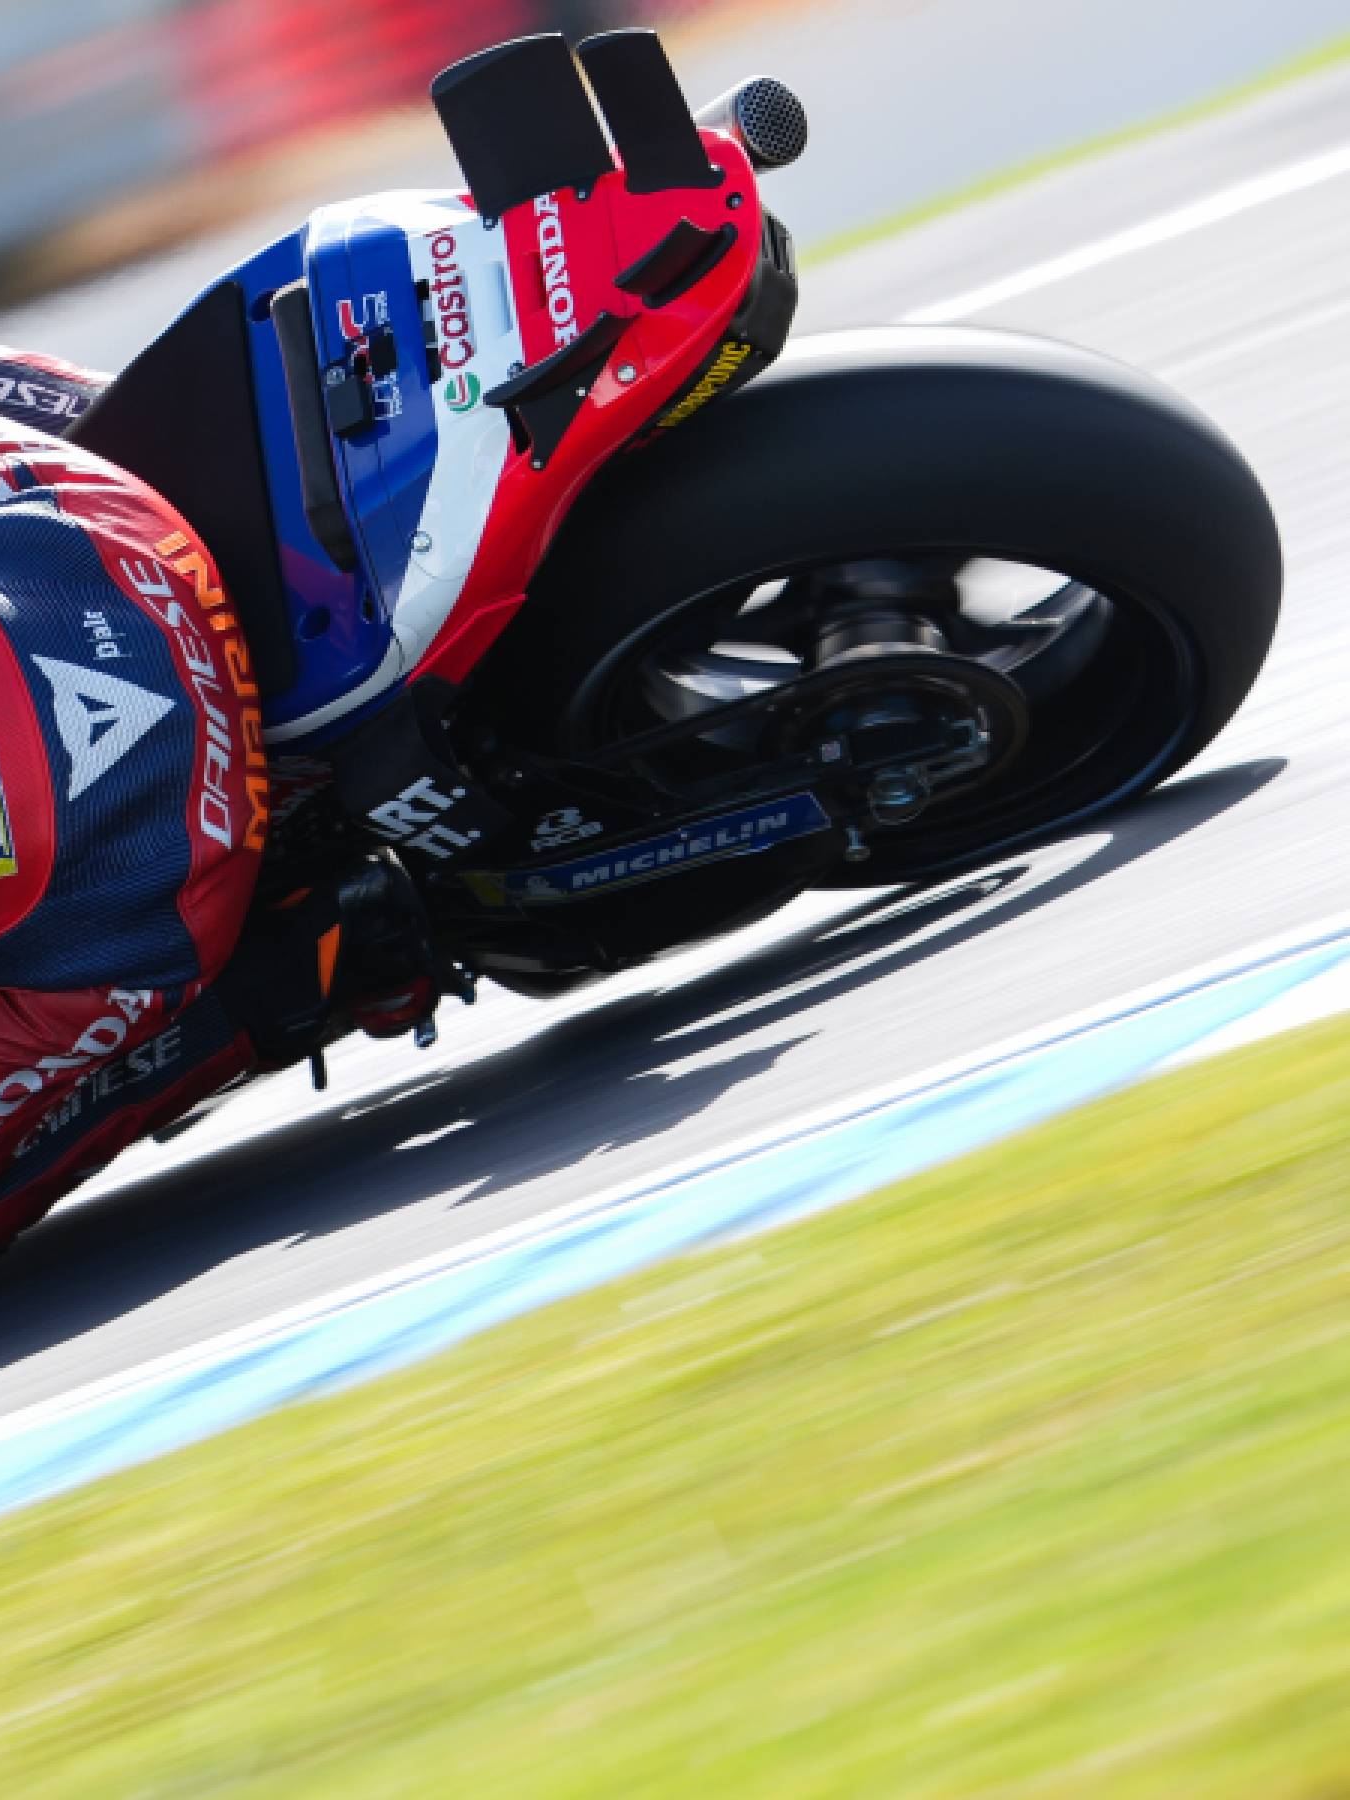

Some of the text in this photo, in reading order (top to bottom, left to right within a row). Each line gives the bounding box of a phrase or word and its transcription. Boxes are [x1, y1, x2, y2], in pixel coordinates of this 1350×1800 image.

[424, 226, 475, 370] Castrol
[119, 556, 233, 850] DAINESE
[155, 530, 269, 852] MARINI
[571, 810, 788, 888] MICHELIN
